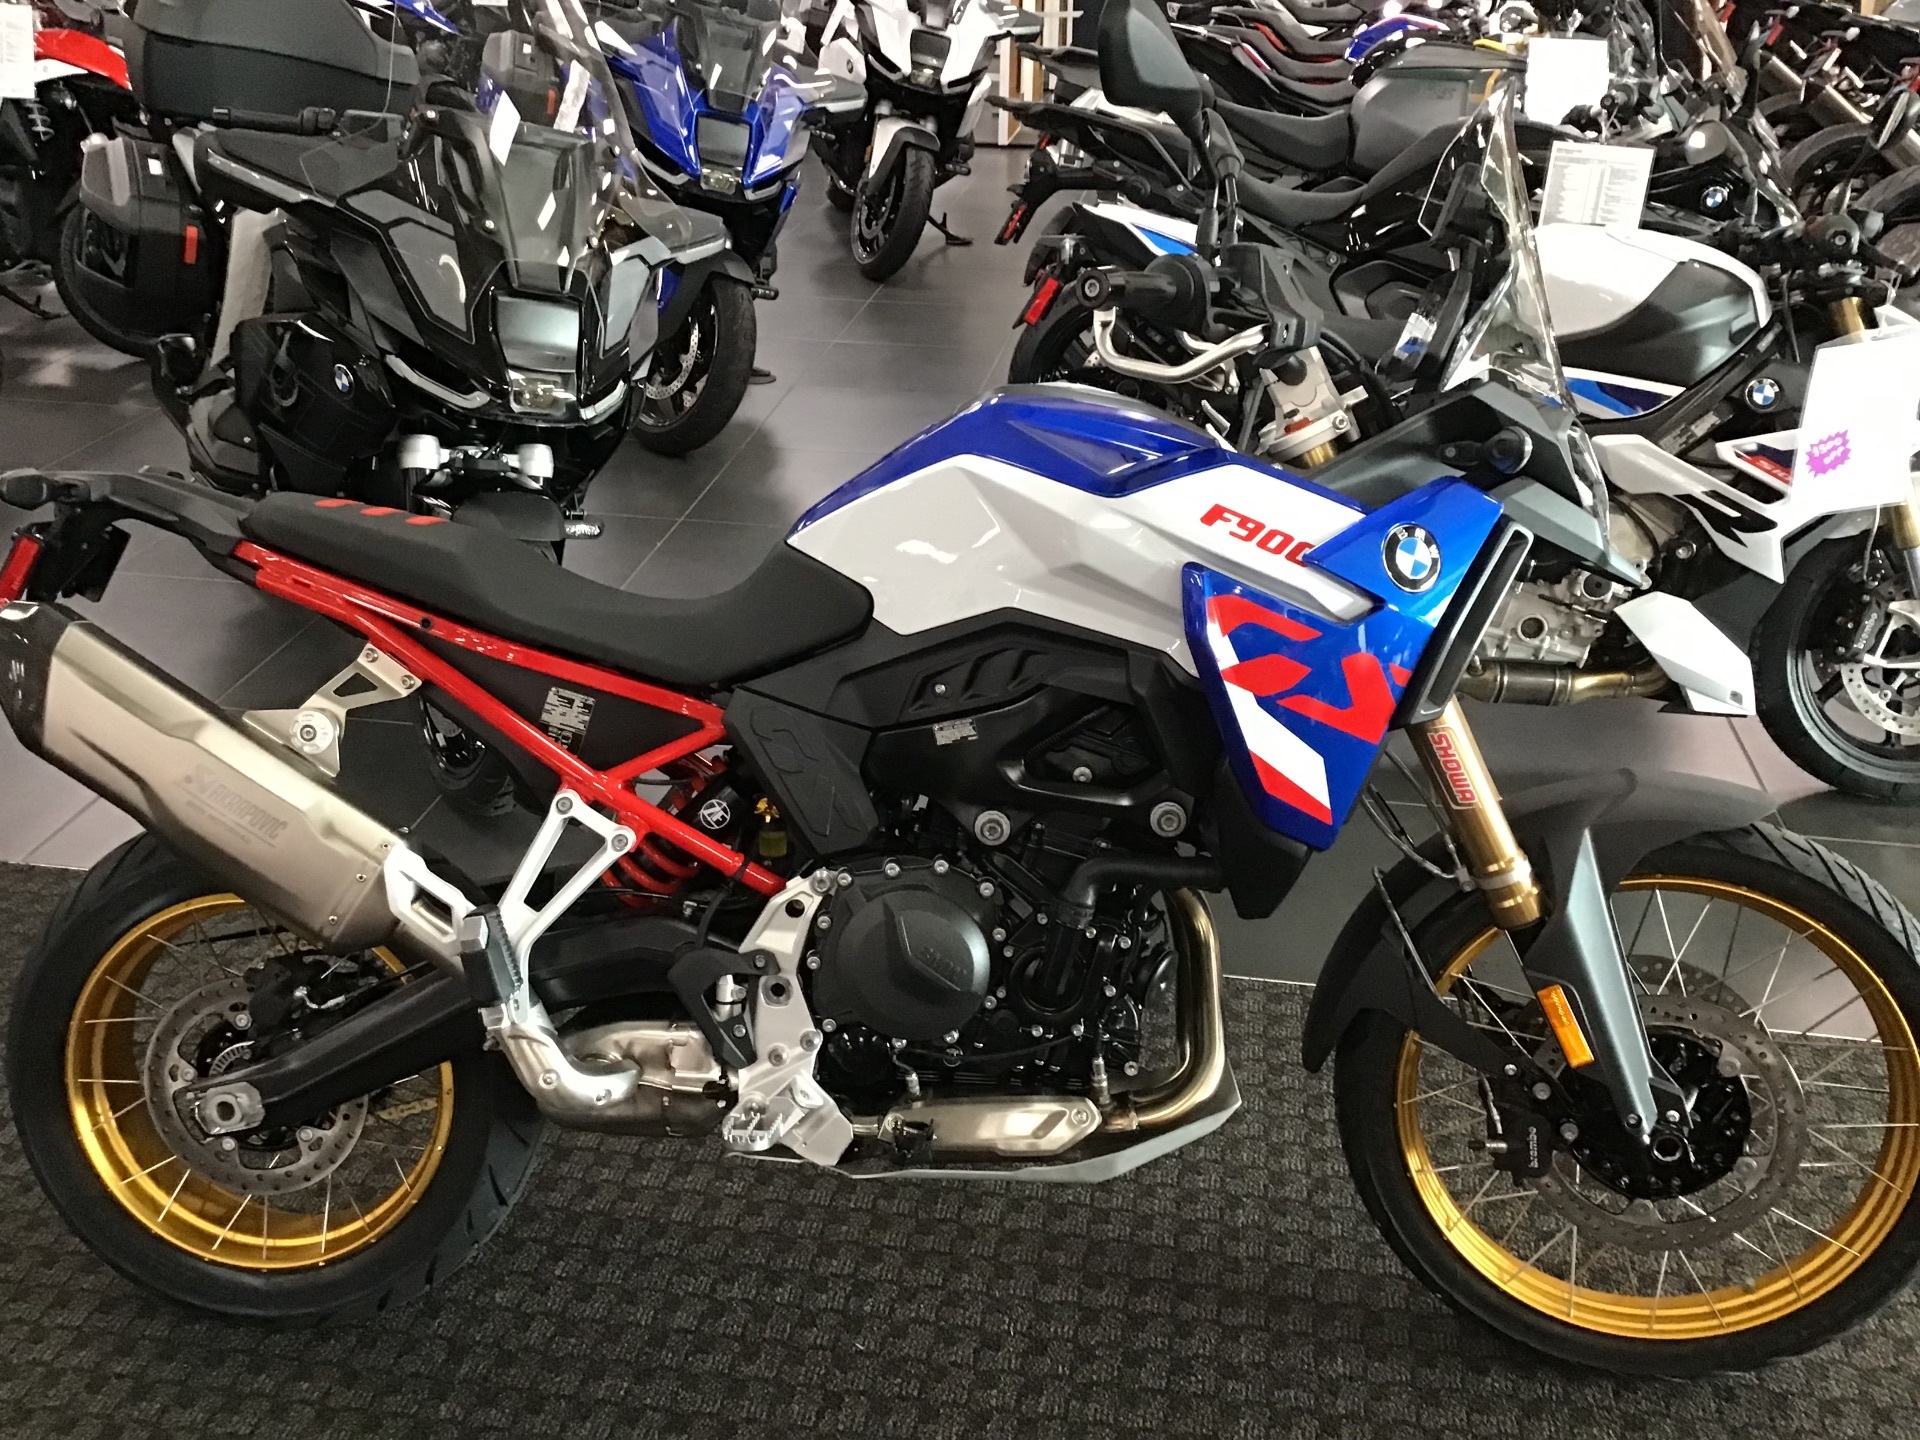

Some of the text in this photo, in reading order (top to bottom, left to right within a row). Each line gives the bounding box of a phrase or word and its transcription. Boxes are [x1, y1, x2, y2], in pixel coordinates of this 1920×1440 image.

[1396, 528, 1440, 558] BMW
[1427, 732, 1477, 803] SHOWA
[1527, 1126, 1539, 1168] brembo
